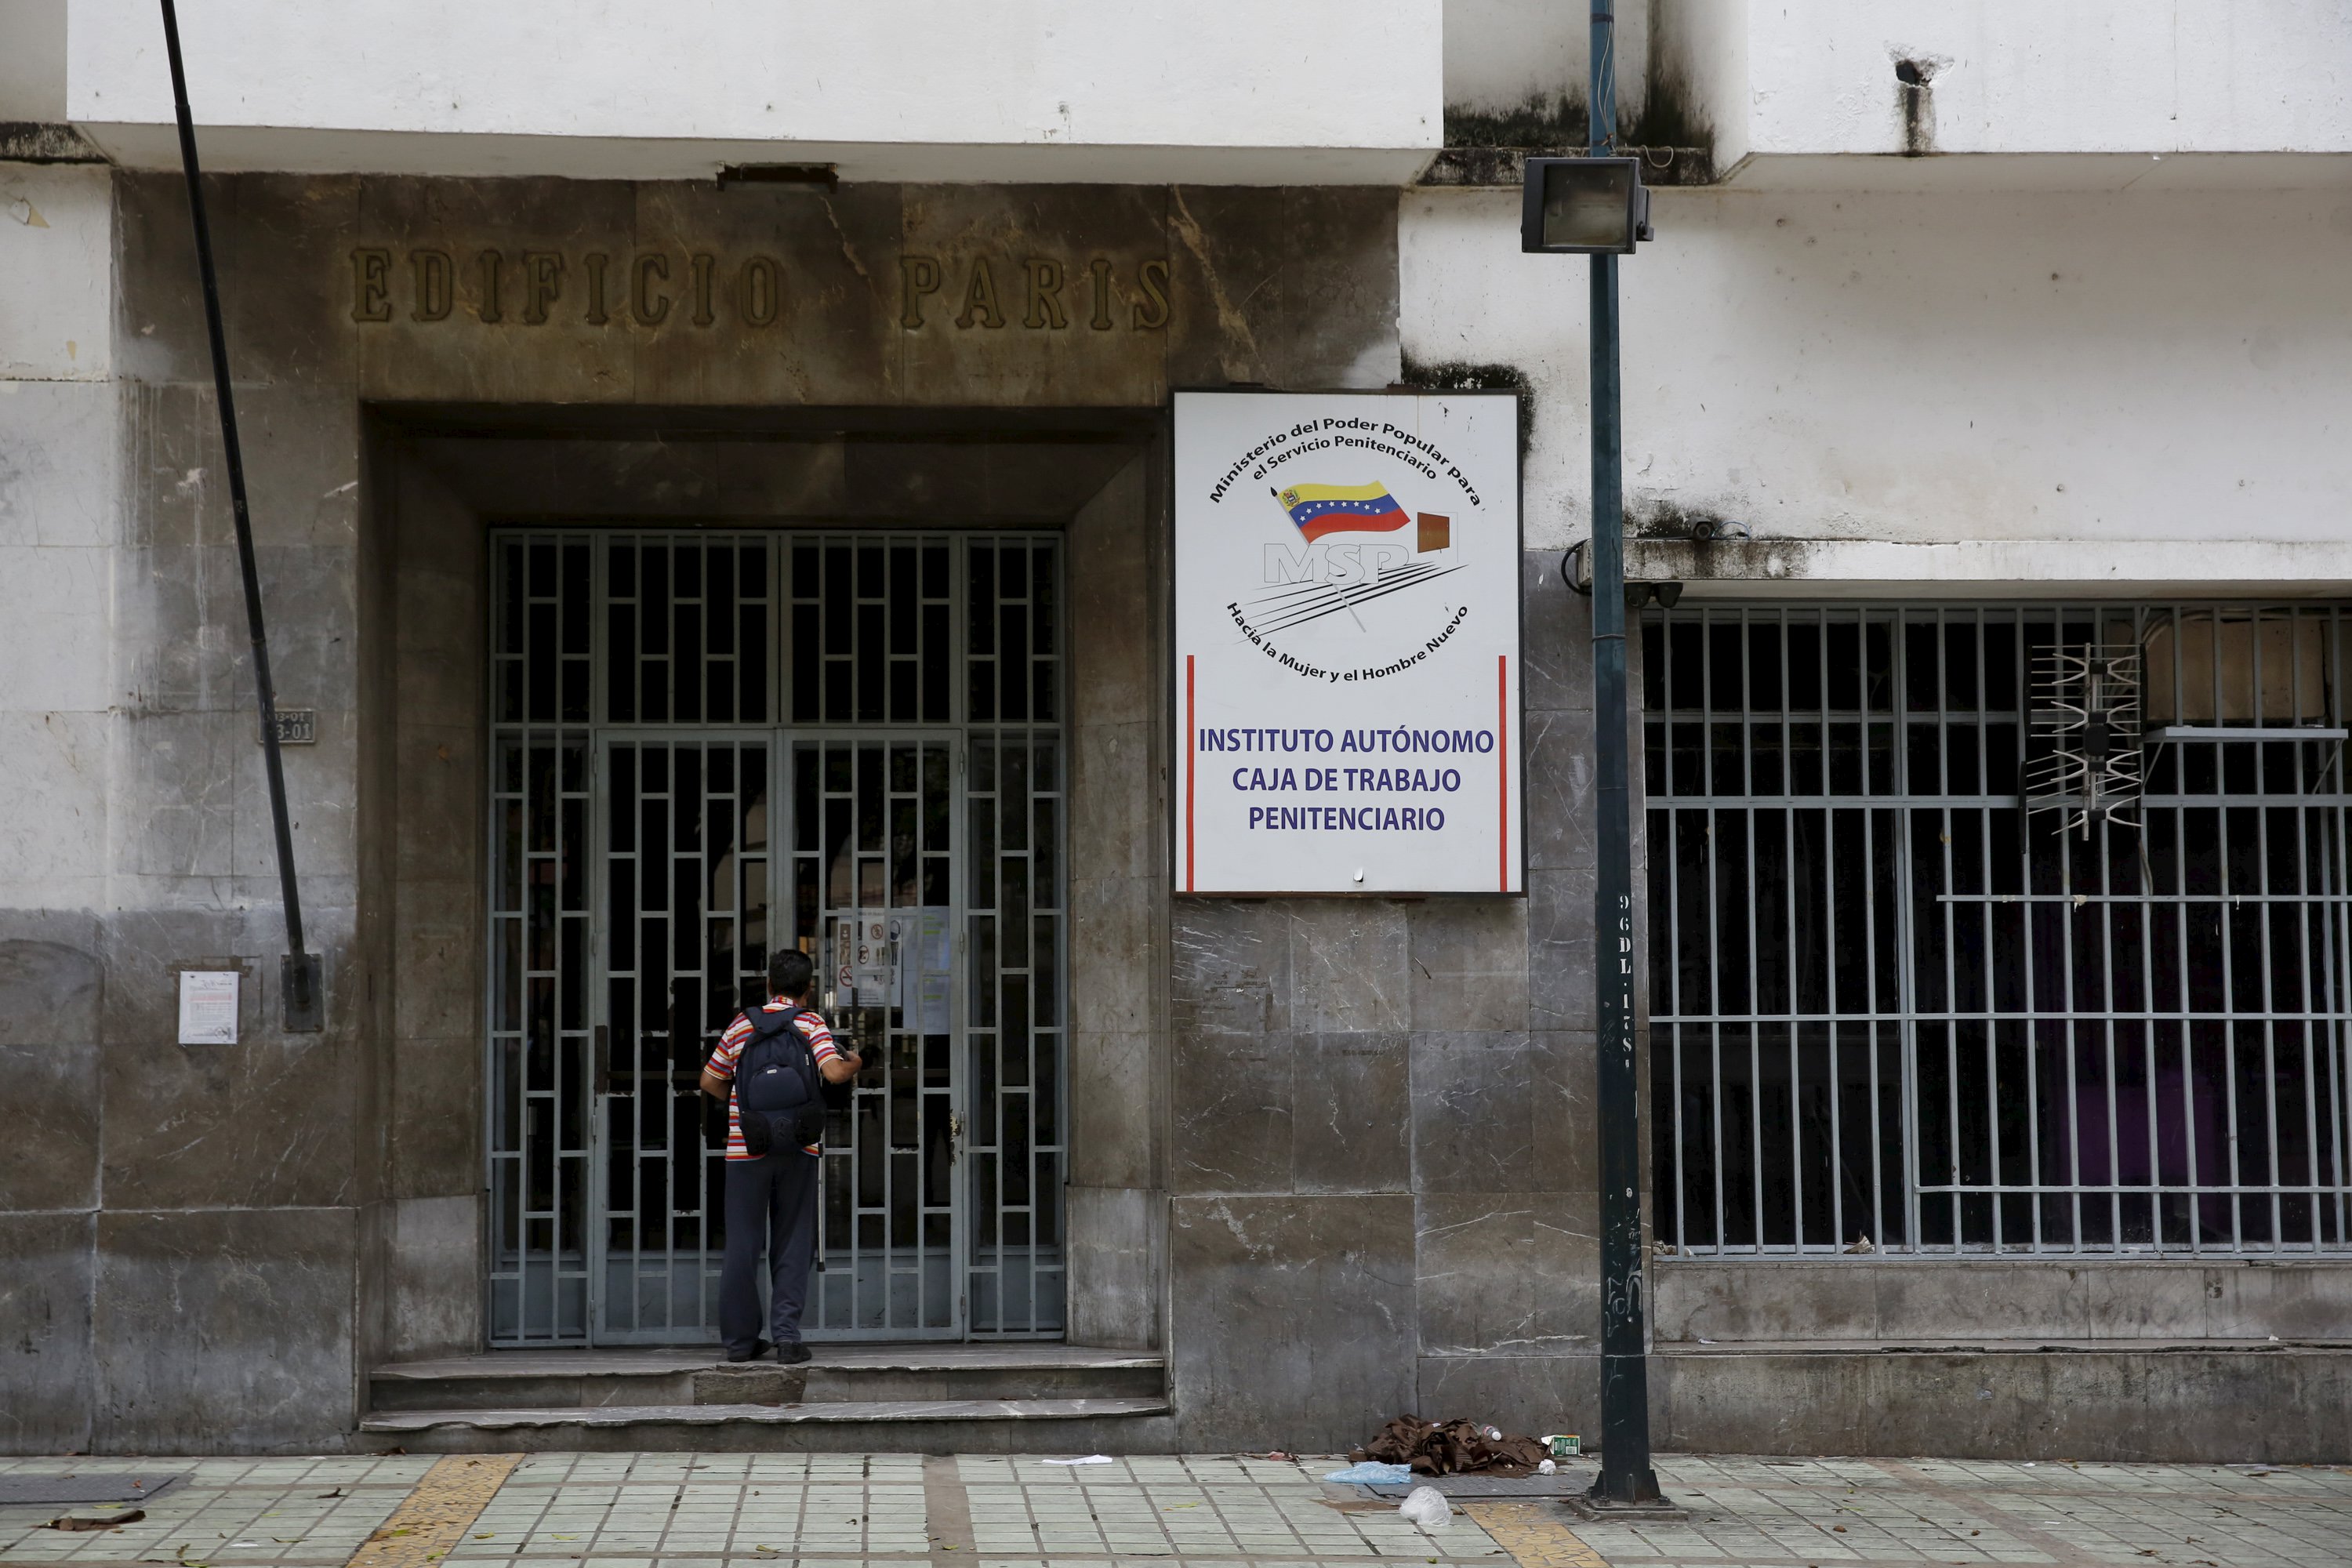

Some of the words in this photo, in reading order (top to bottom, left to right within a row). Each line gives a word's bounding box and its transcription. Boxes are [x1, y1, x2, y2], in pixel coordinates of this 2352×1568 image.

[350, 247, 779, 327] EDIFICIO
[899, 256, 1171, 331] PARIS
[1210, 434, 1287, 503] Ministerio
[1290, 419, 1319, 437] del
[1323, 418, 1379, 431] Poder
[1382, 423, 1450, 466] Popular
[1446, 466, 1480, 506] para
[1253, 463, 1268, 481] el
[1267, 437, 1330, 469] Servicio
[1334, 435, 1436, 480] Penitenciario
[1264, 543, 1410, 585] MSP
[1227, 602, 1261, 646] Hacia
[1262, 641, 1277, 659] la
[1278, 652, 1327, 679] Mujer
[1330, 671, 1340, 683] y
[1343, 669, 1358, 681] el
[1362, 651, 1427, 681] Hombre
[1425, 606, 1468, 653] Nuevo
[1200, 728, 1334, 753] INSTITUTO
[1341, 724, 1494, 753] AUTÓNOMO
[1232, 768, 1298, 791] CAJA
[1305, 768, 1338, 791] DE
[1343, 768, 1461, 792] TRABAJO
[1249, 807, 1445, 831] PENITENCIARIO
